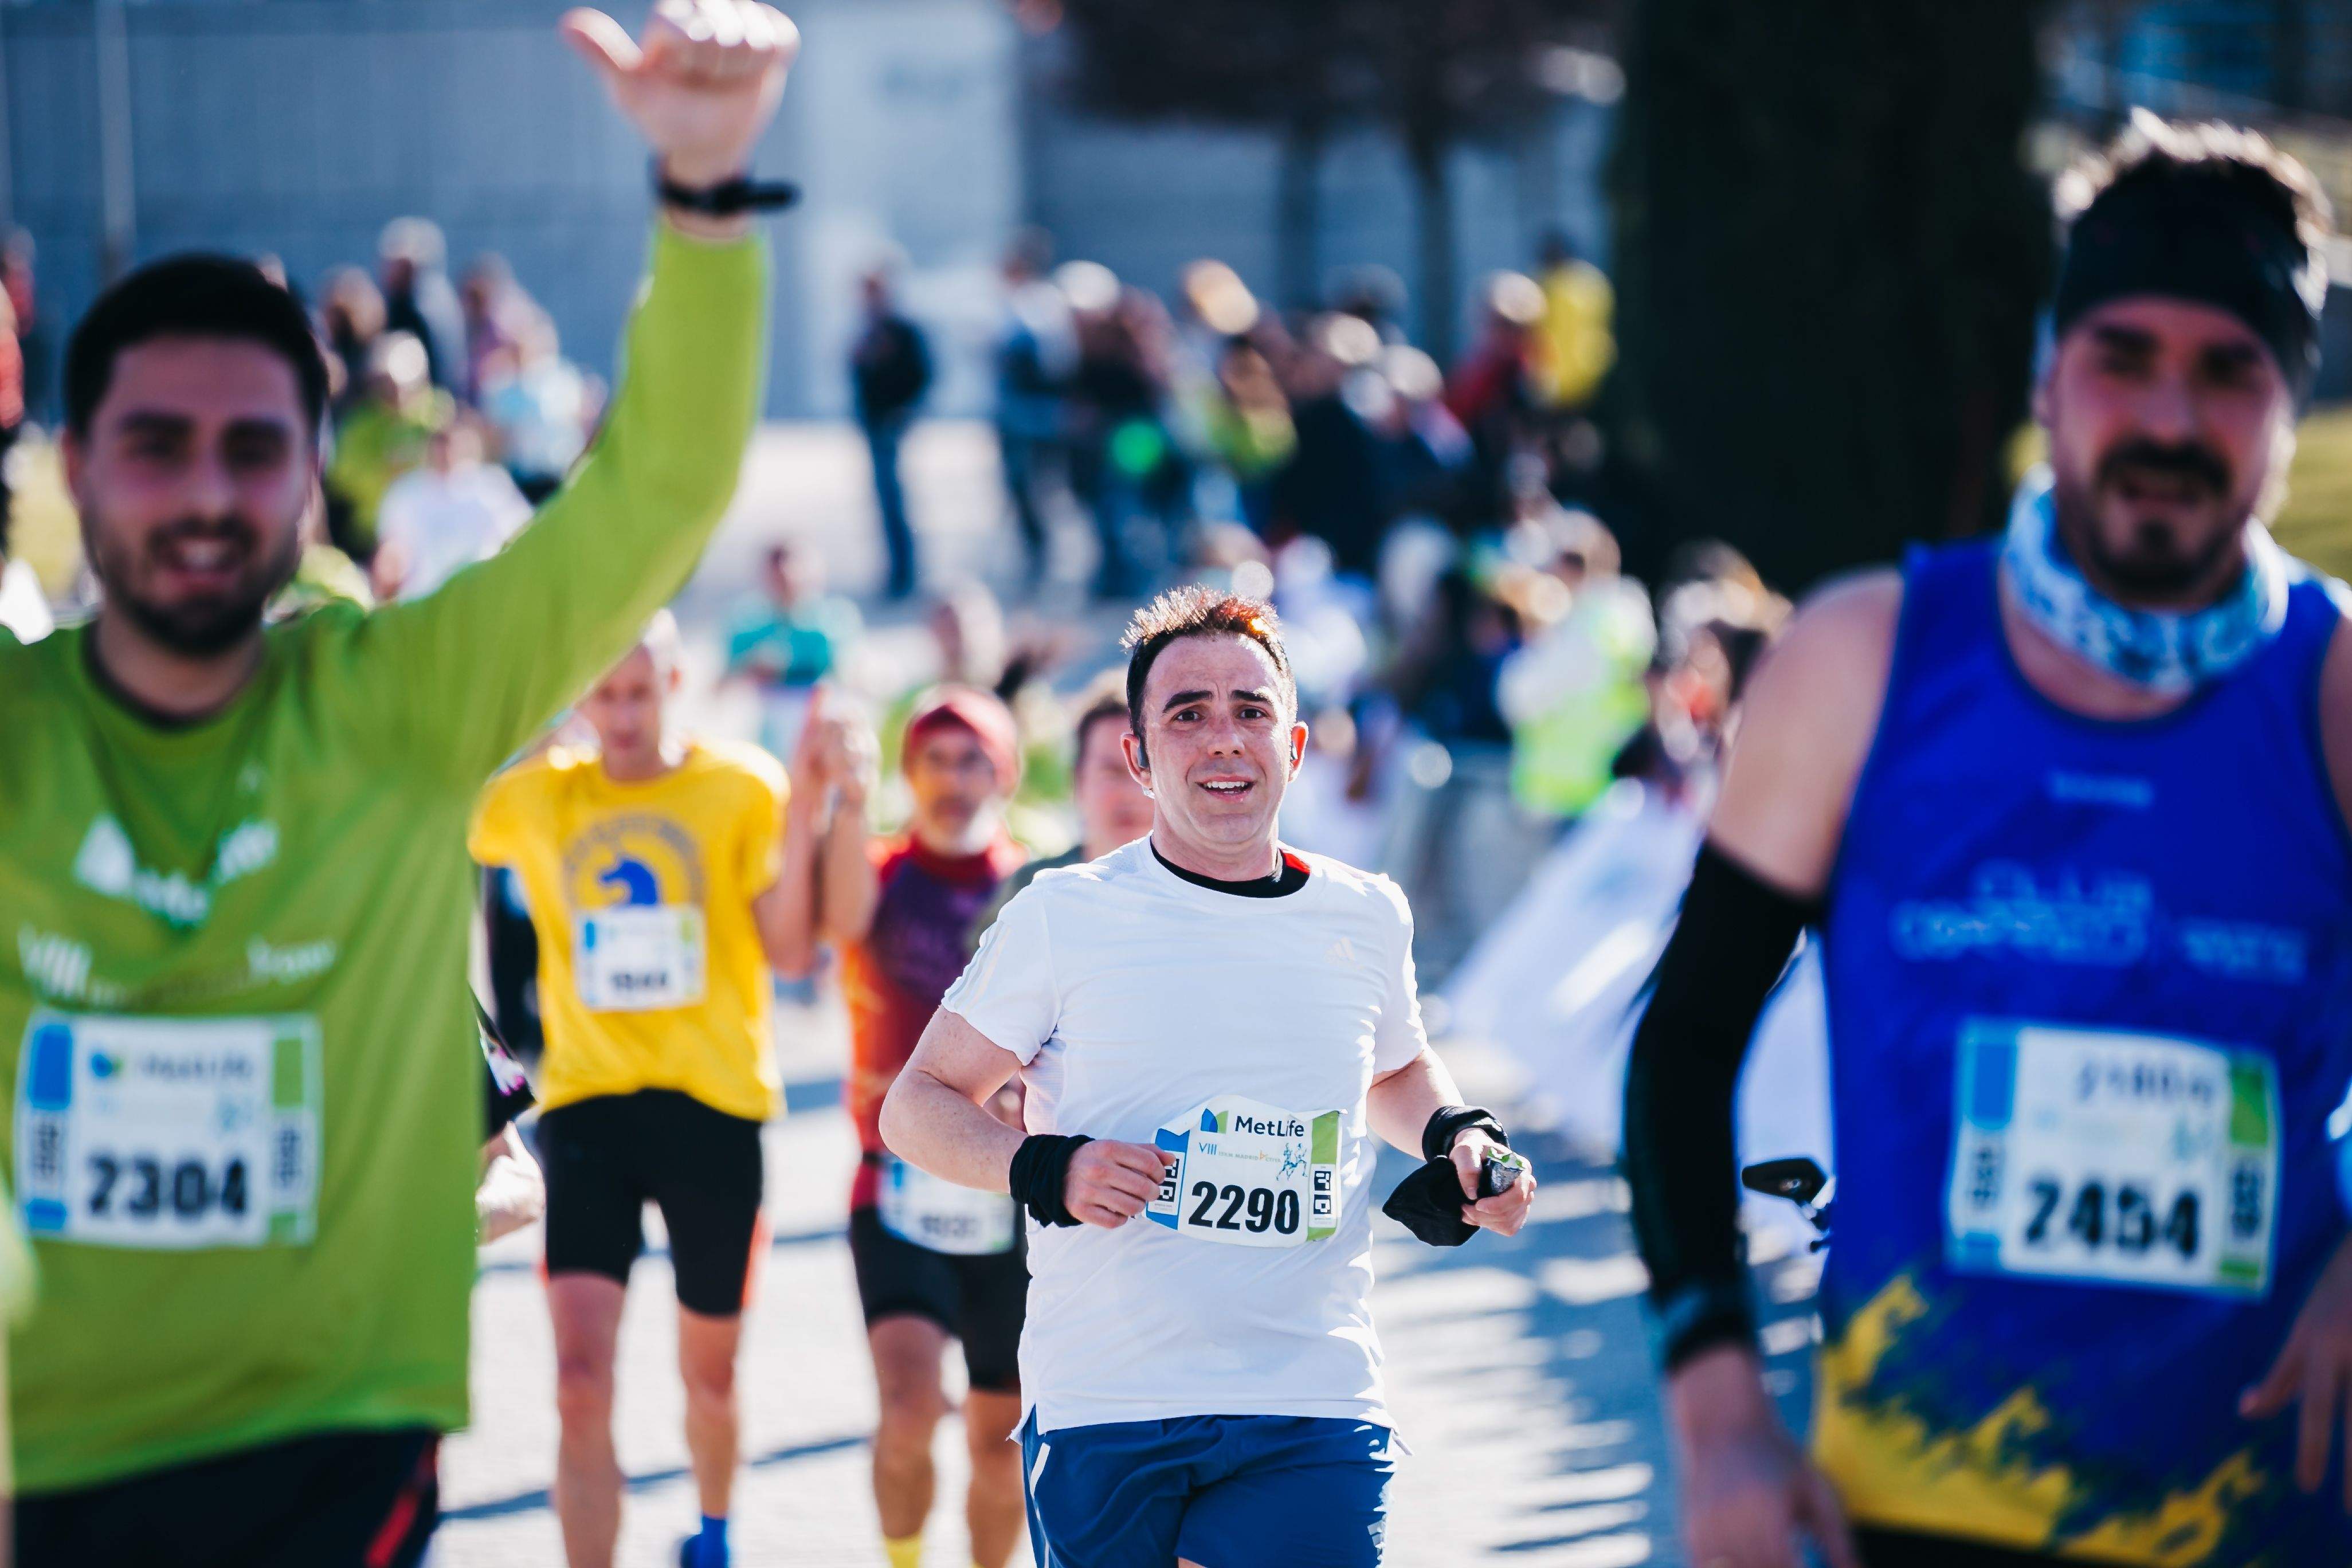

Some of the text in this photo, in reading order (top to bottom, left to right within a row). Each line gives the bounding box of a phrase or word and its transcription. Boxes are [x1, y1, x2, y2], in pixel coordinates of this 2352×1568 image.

[1235, 1115, 1304, 1137] MetLife
[1199, 1142, 1217, 1155] VIII
[88, 1152, 248, 1222] 2304
[1188, 1181, 1299, 1234] 2290
